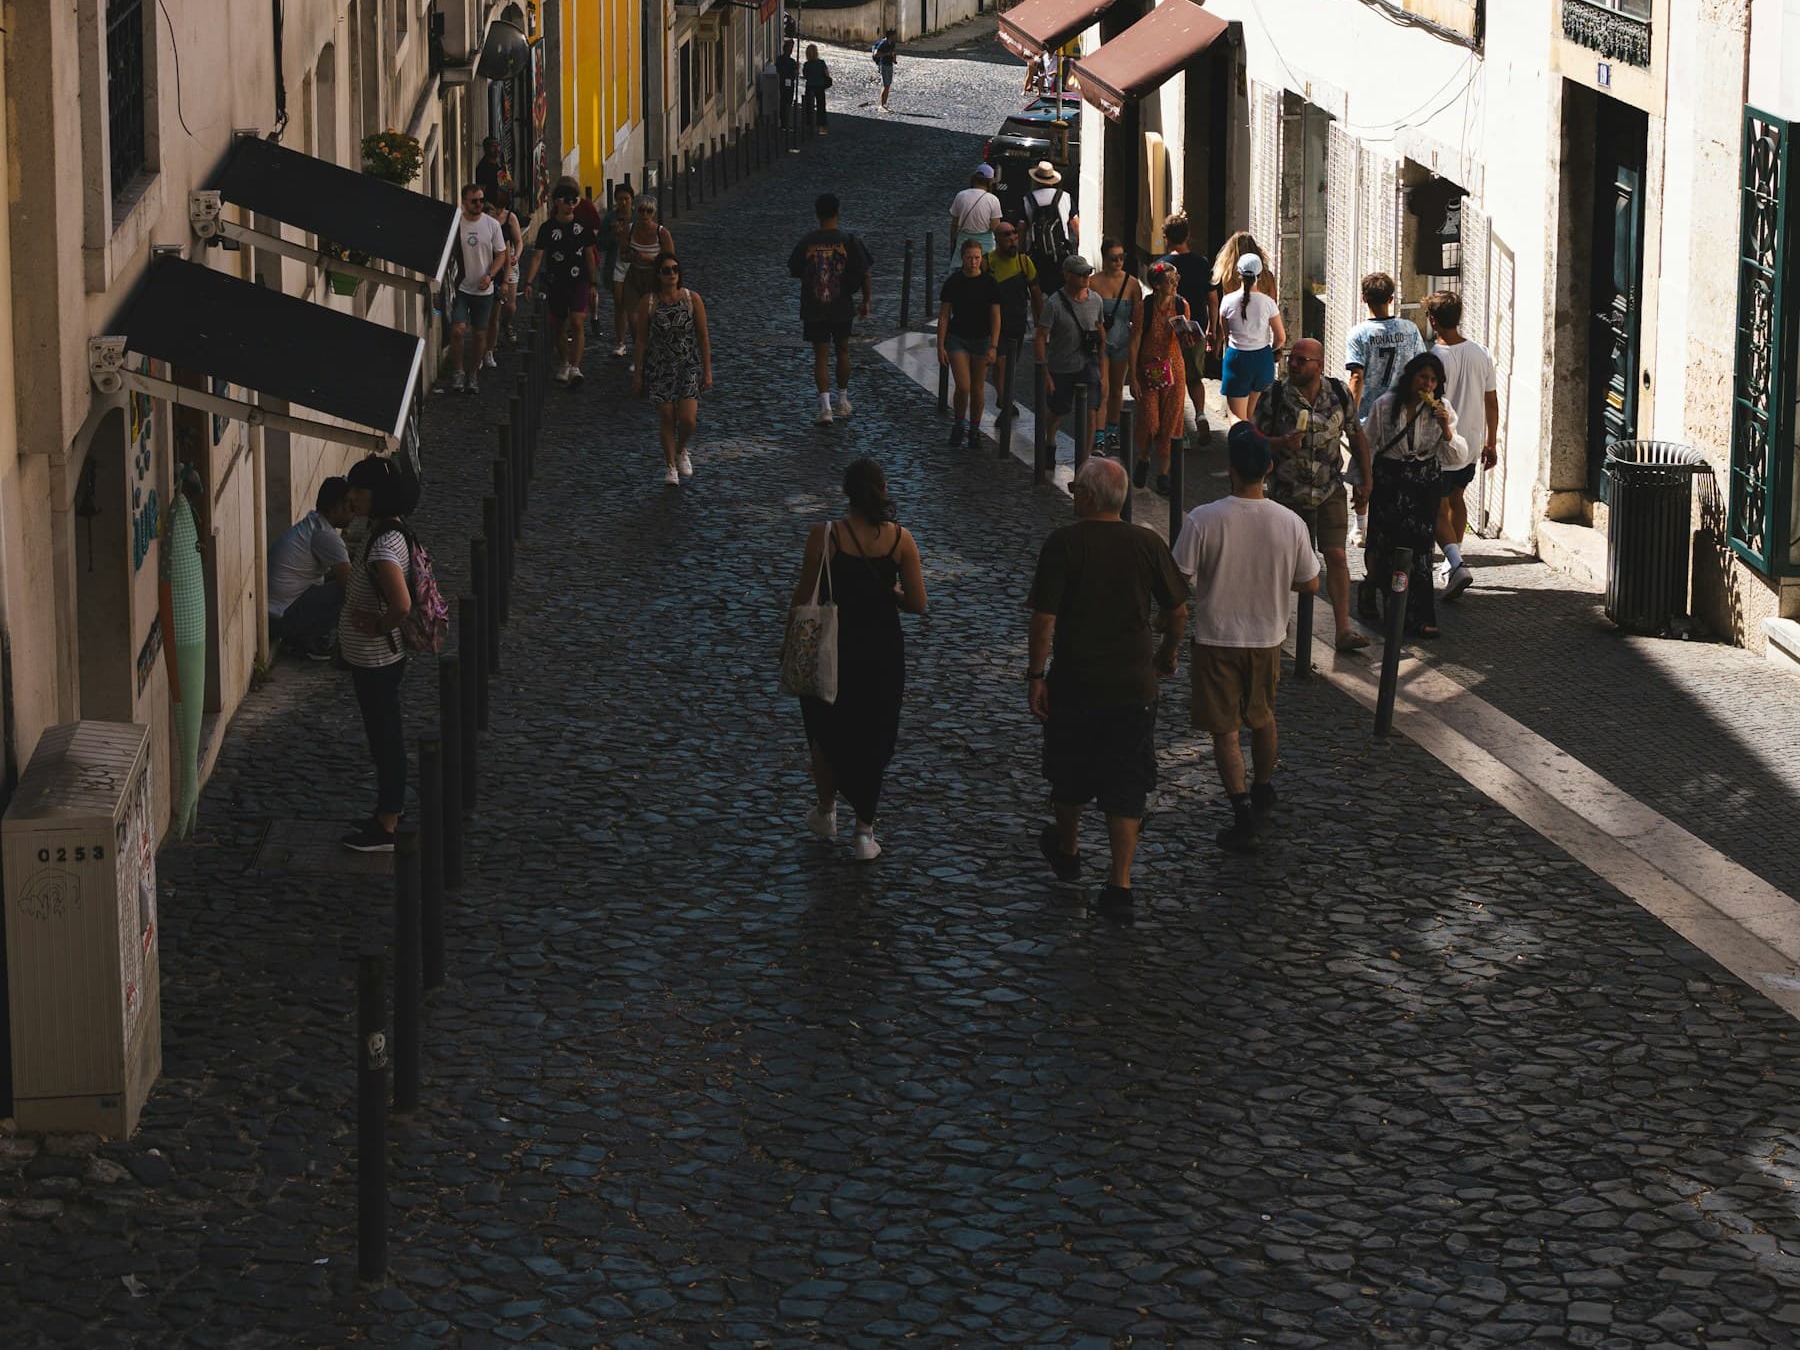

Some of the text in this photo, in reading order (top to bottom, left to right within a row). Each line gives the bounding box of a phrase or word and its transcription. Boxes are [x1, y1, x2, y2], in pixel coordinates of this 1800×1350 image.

[1369, 333, 1404, 346] RONALDO
[1379, 347, 1396, 387] 7
[38, 846, 104, 862] 0253
